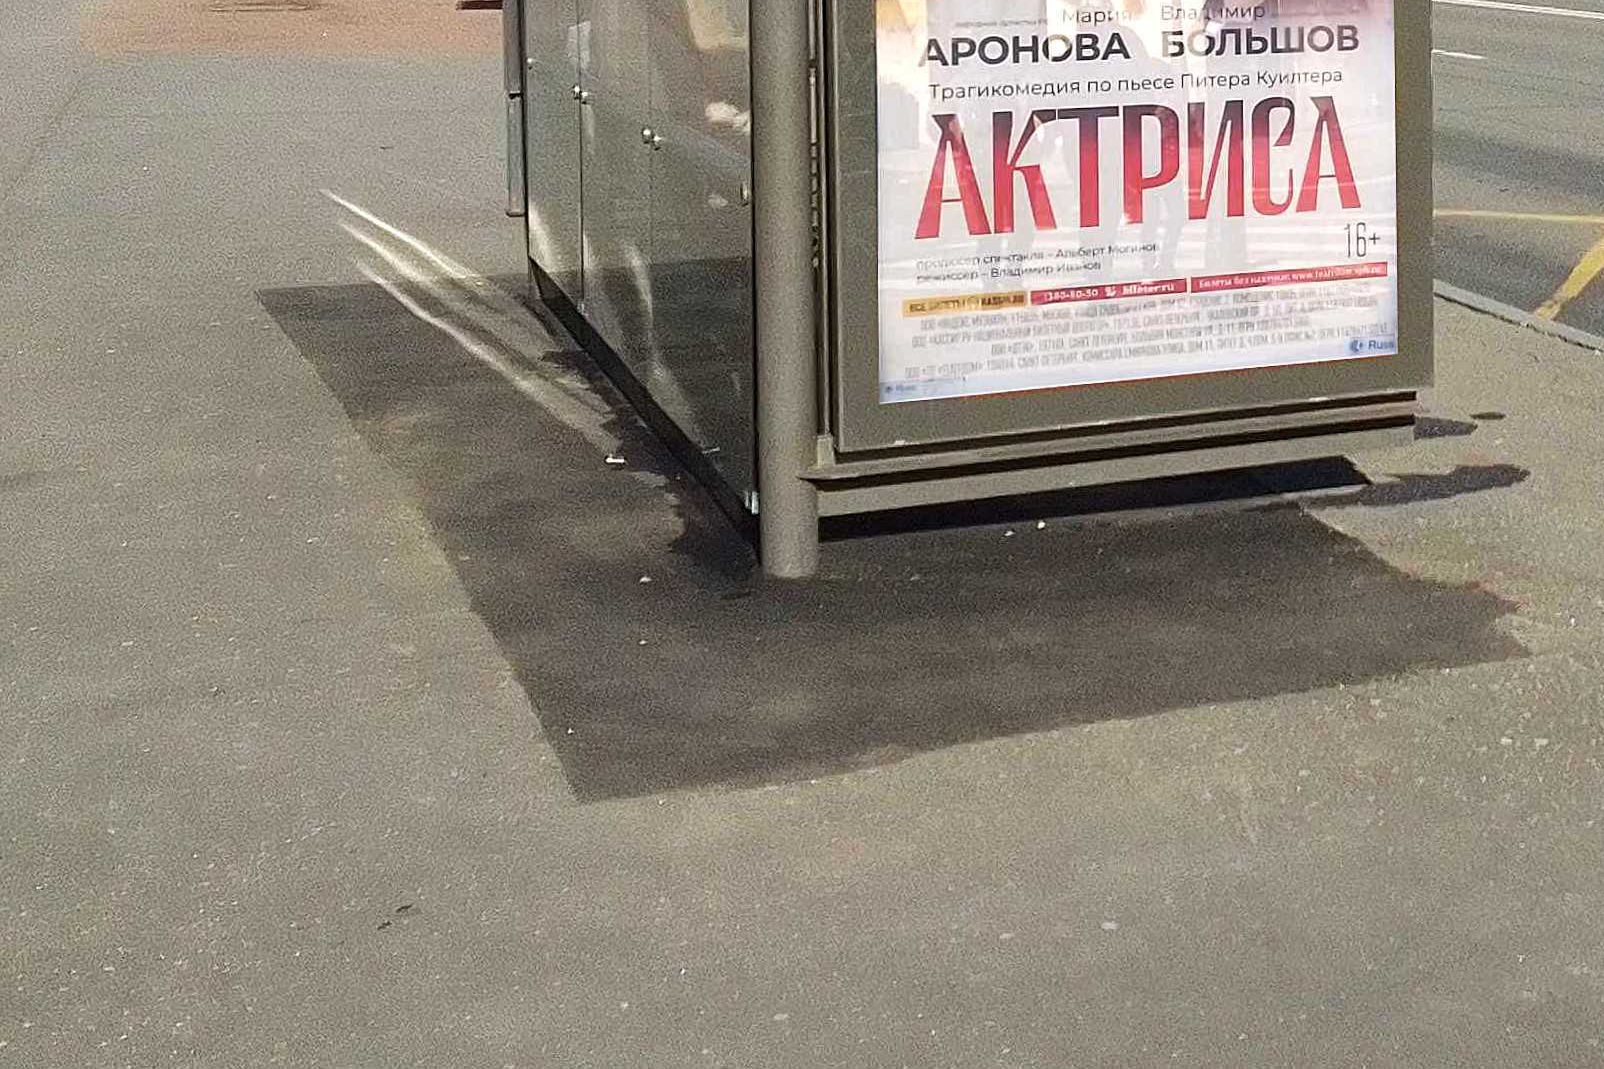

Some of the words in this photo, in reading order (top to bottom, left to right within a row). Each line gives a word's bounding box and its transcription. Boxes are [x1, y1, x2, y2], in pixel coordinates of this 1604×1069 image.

[1062, 7, 1132, 25] Мария
[1160, 4, 1266, 23] Владимир
[921, 31, 1132, 67] АРОНОВА
[1160, 24, 1360, 58] БОЛЬШОВ
[929, 79, 1081, 102] Трагикомедия
[1087, 79, 1112, 92] по
[1117, 76, 1175, 91] пьесе
[1180, 72, 1251, 90] Питера
[1256, 70, 1343, 89] Куилтера
[915, 96, 1362, 239] АКТРИСА
[1344, 221, 1381, 258] 16+
